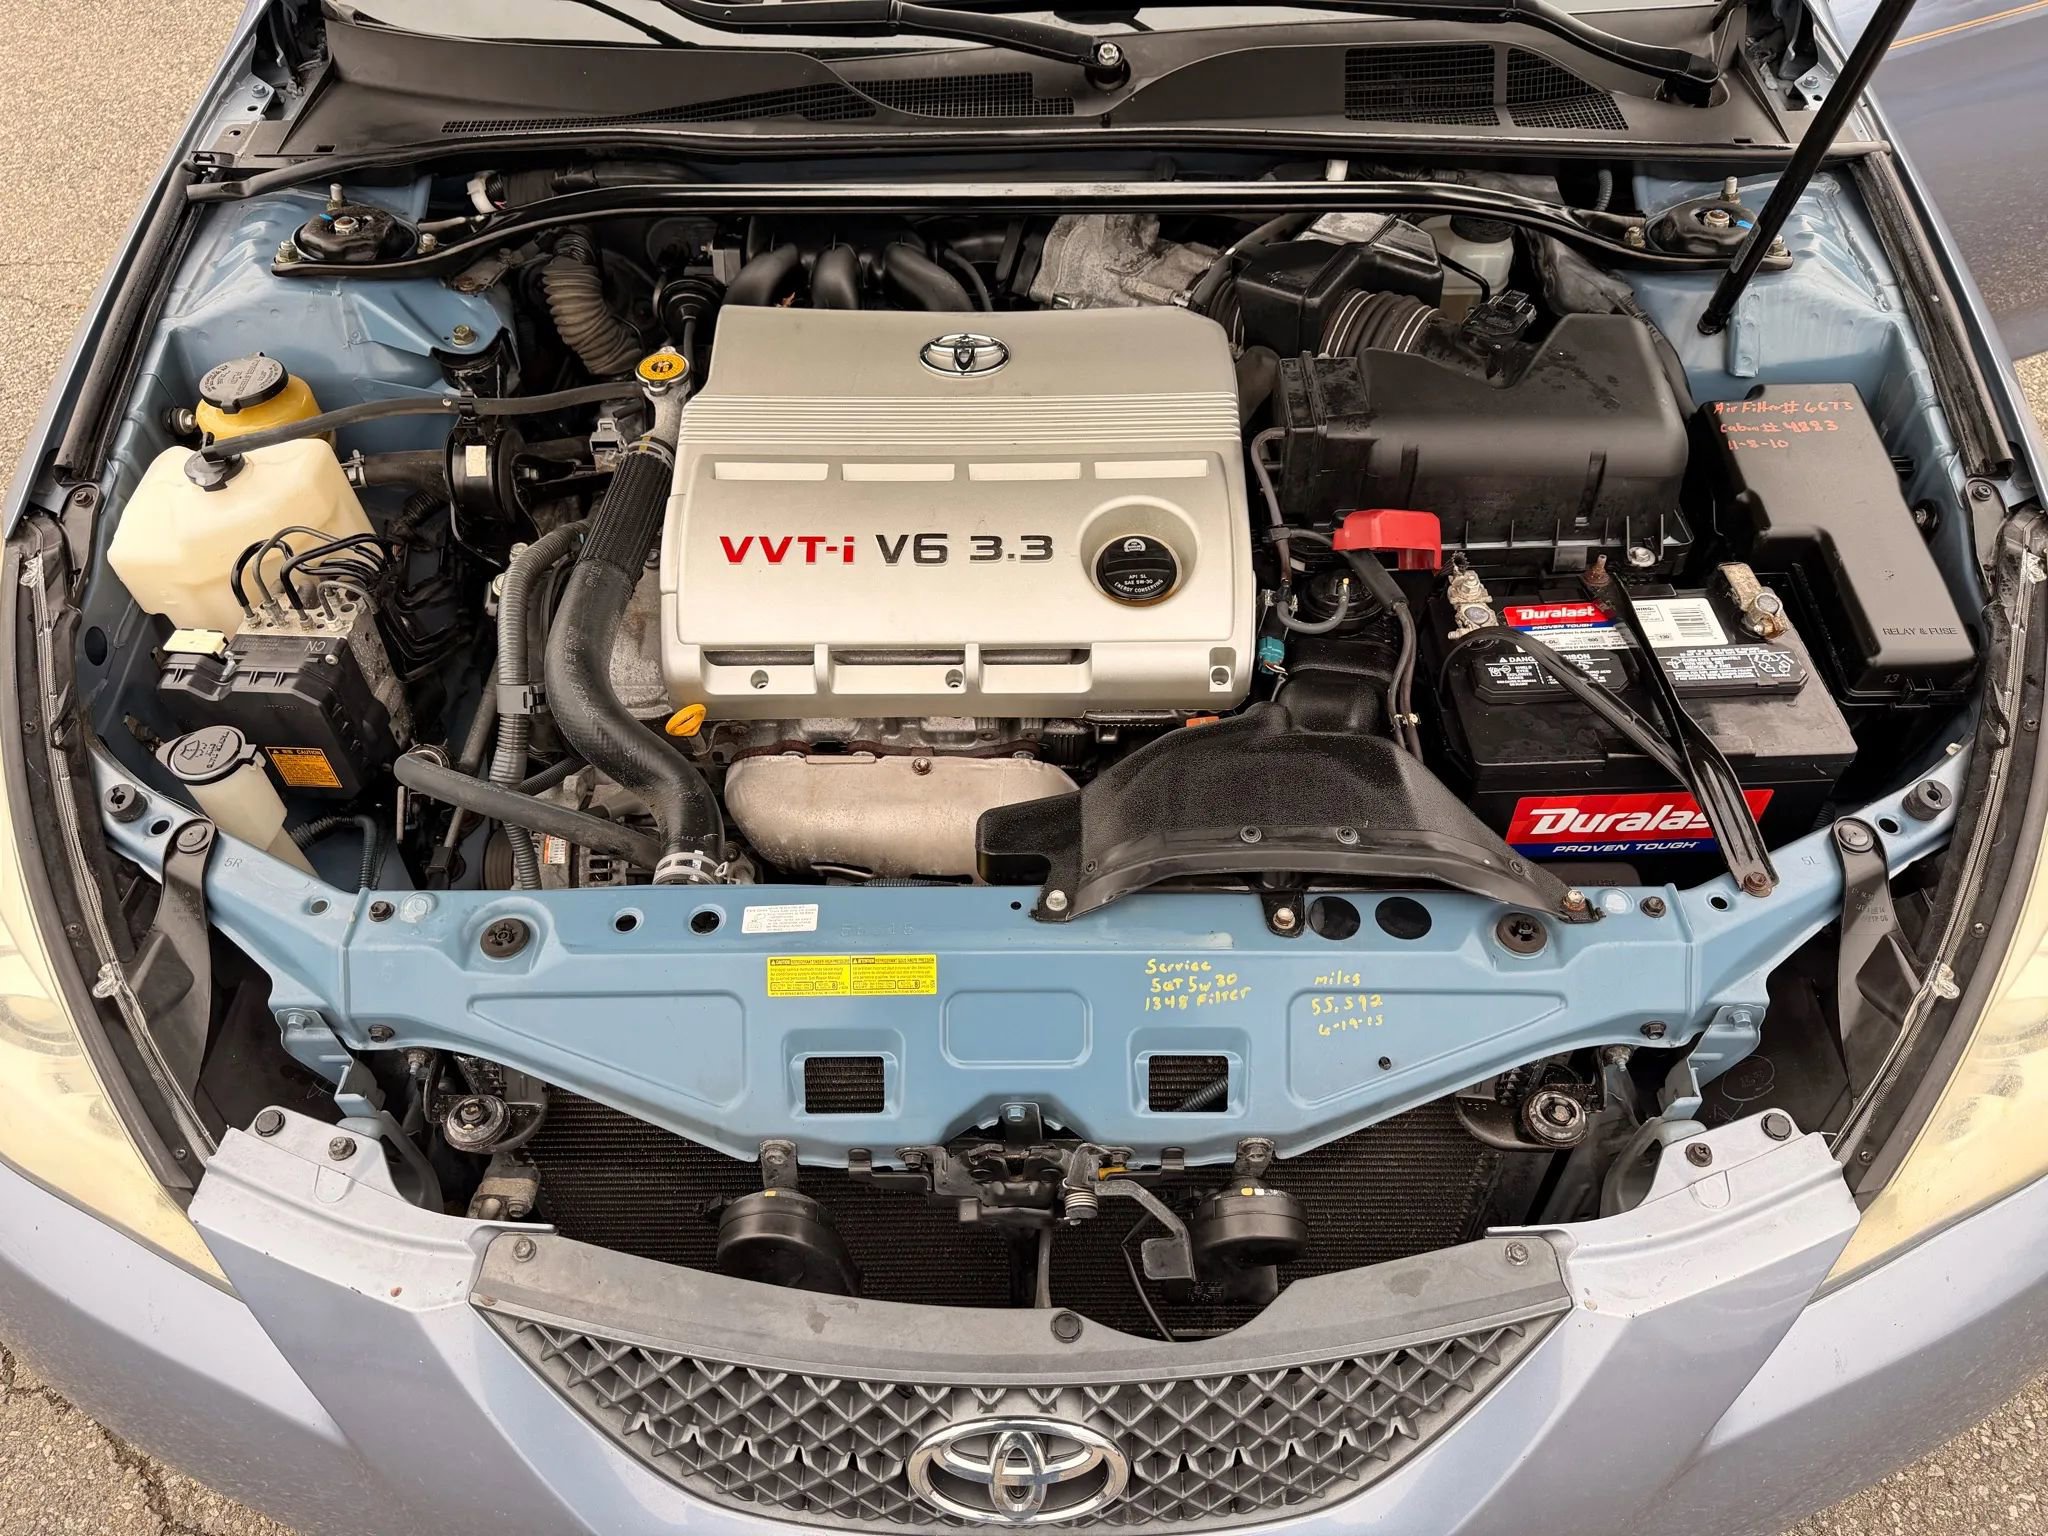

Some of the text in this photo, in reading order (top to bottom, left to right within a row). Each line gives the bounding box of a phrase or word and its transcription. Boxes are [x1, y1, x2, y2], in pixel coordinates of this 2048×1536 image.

[719, 533, 1054, 566] VVT-i V6 3.3
[1114, 581, 1133, 592] ENERGY
[1516, 606, 1595, 620] Duralast
[1882, 627, 1958, 635] RELAY & FUSE
[1529, 804, 1710, 835] Duralas
[1552, 841, 1696, 853] PROVEN TOUGH
[1313, 969, 1361, 987] miles
[1144, 995, 1188, 1011] 1348
